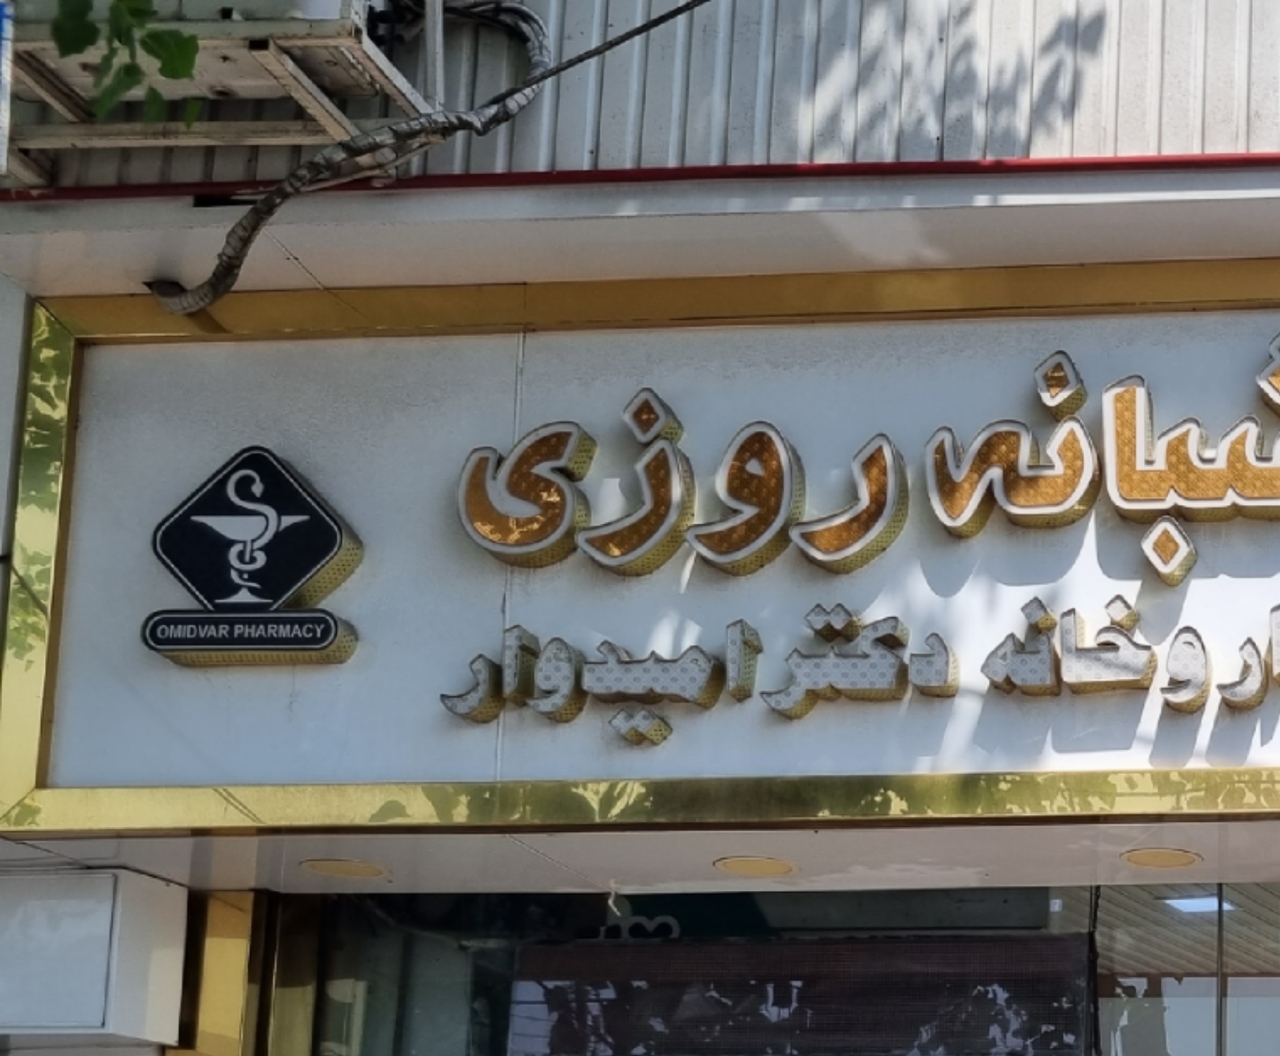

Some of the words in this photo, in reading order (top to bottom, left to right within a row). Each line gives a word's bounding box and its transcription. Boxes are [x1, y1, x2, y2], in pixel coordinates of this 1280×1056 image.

[458, 387, 908, 576] روزی
[157, 623, 229, 639] OMIDVAR
[233, 623, 324, 640] PHARMACY
[441, 618, 762, 746] امیدوار
[760, 602, 958, 718] دکتر
